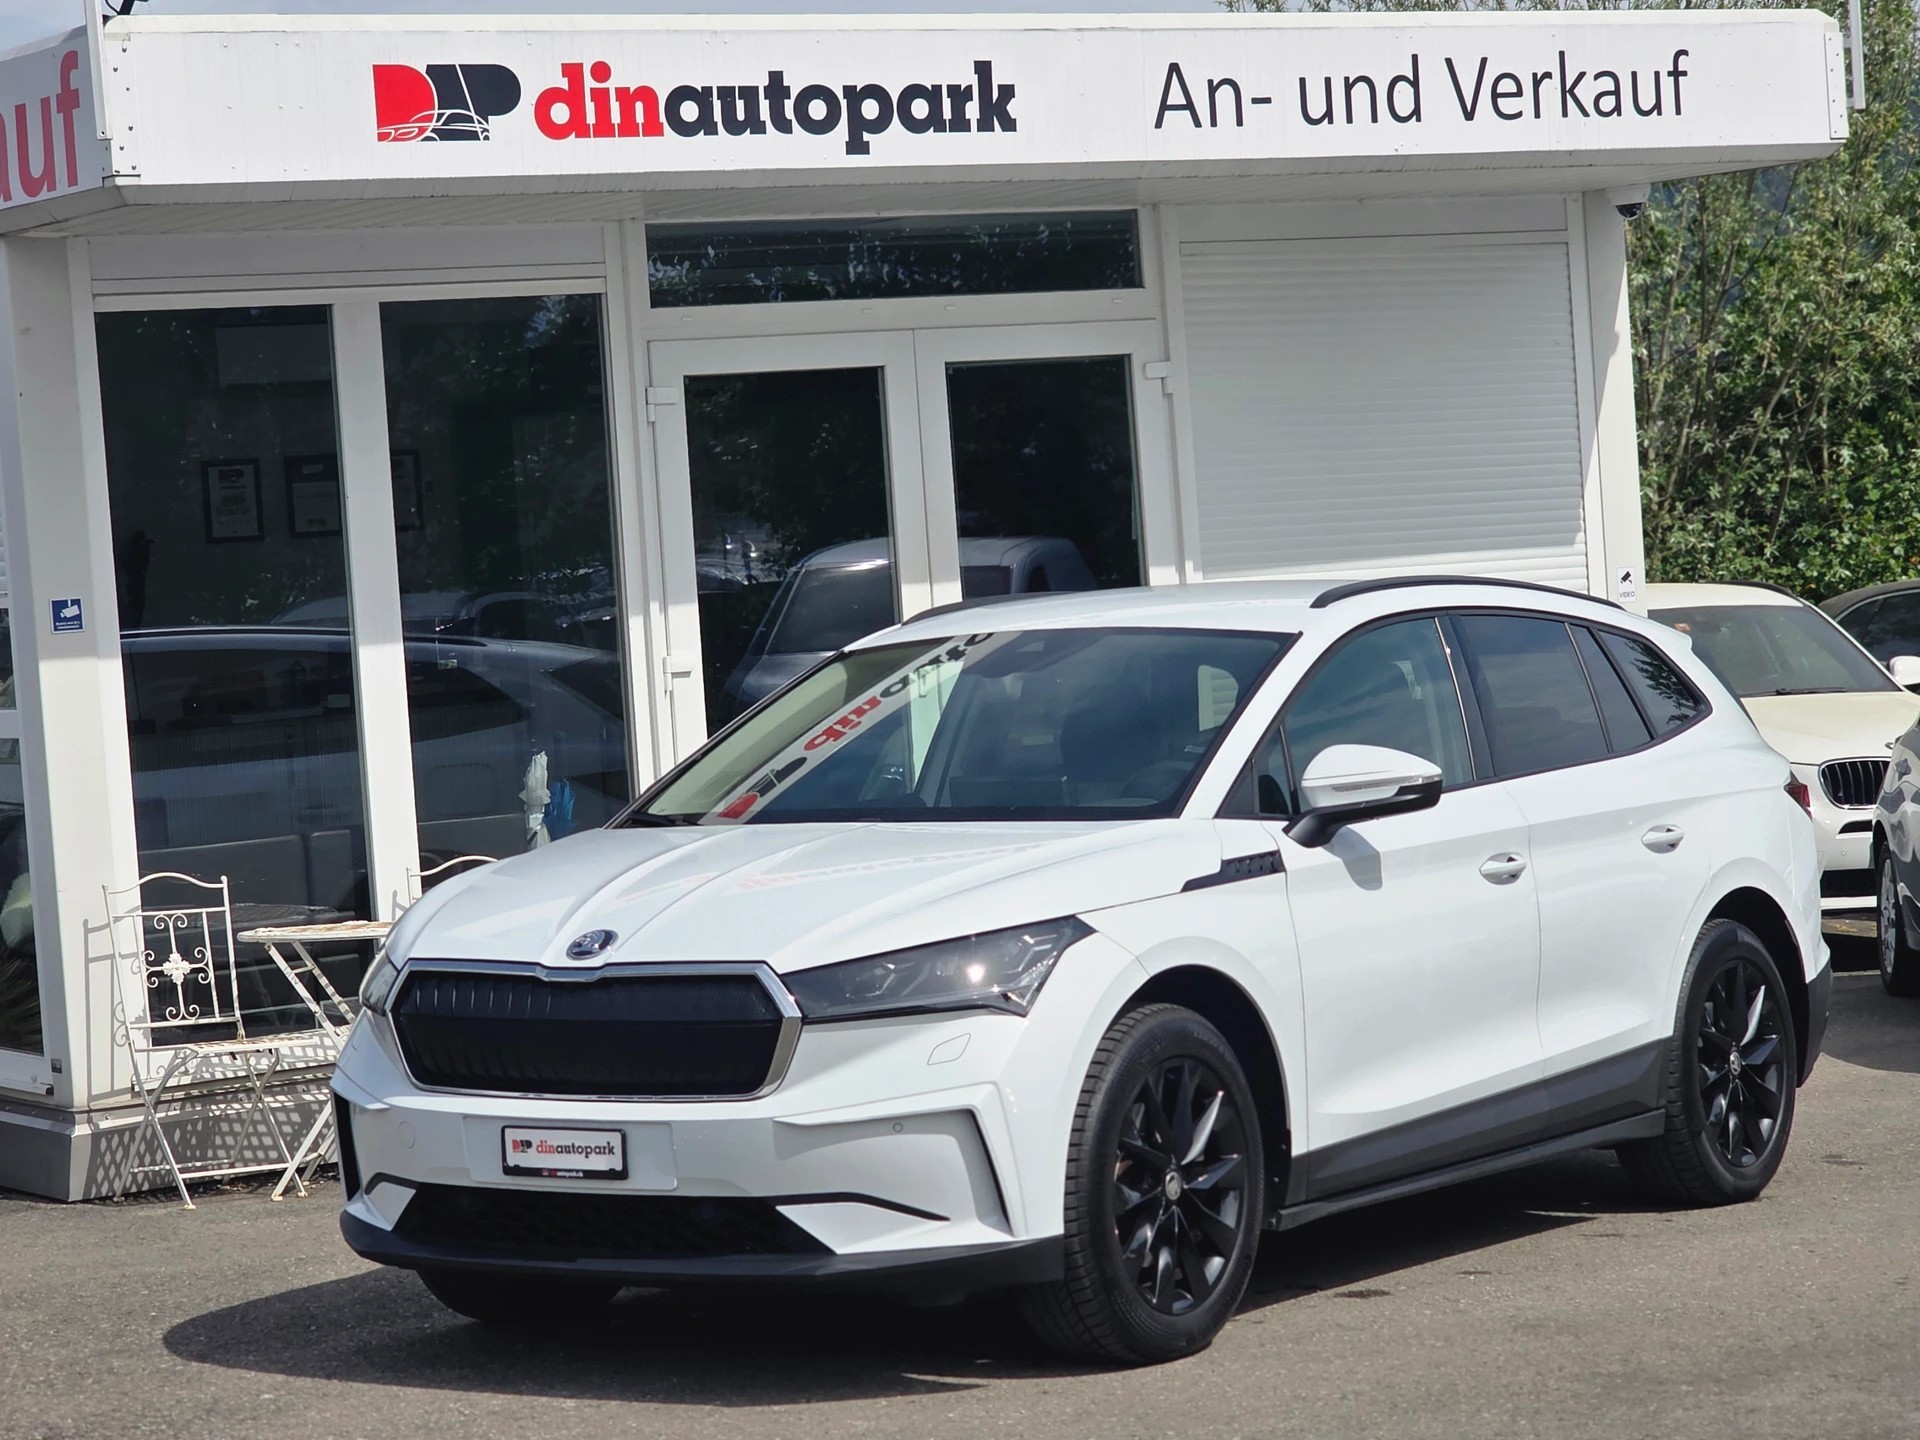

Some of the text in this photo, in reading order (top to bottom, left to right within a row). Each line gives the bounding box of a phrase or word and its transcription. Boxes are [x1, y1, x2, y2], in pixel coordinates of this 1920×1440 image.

[534, 60, 1017, 155] dinautopark
[1154, 48, 1689, 129] An- und Verkauf
[535, 1140, 616, 1159] dinautopark
